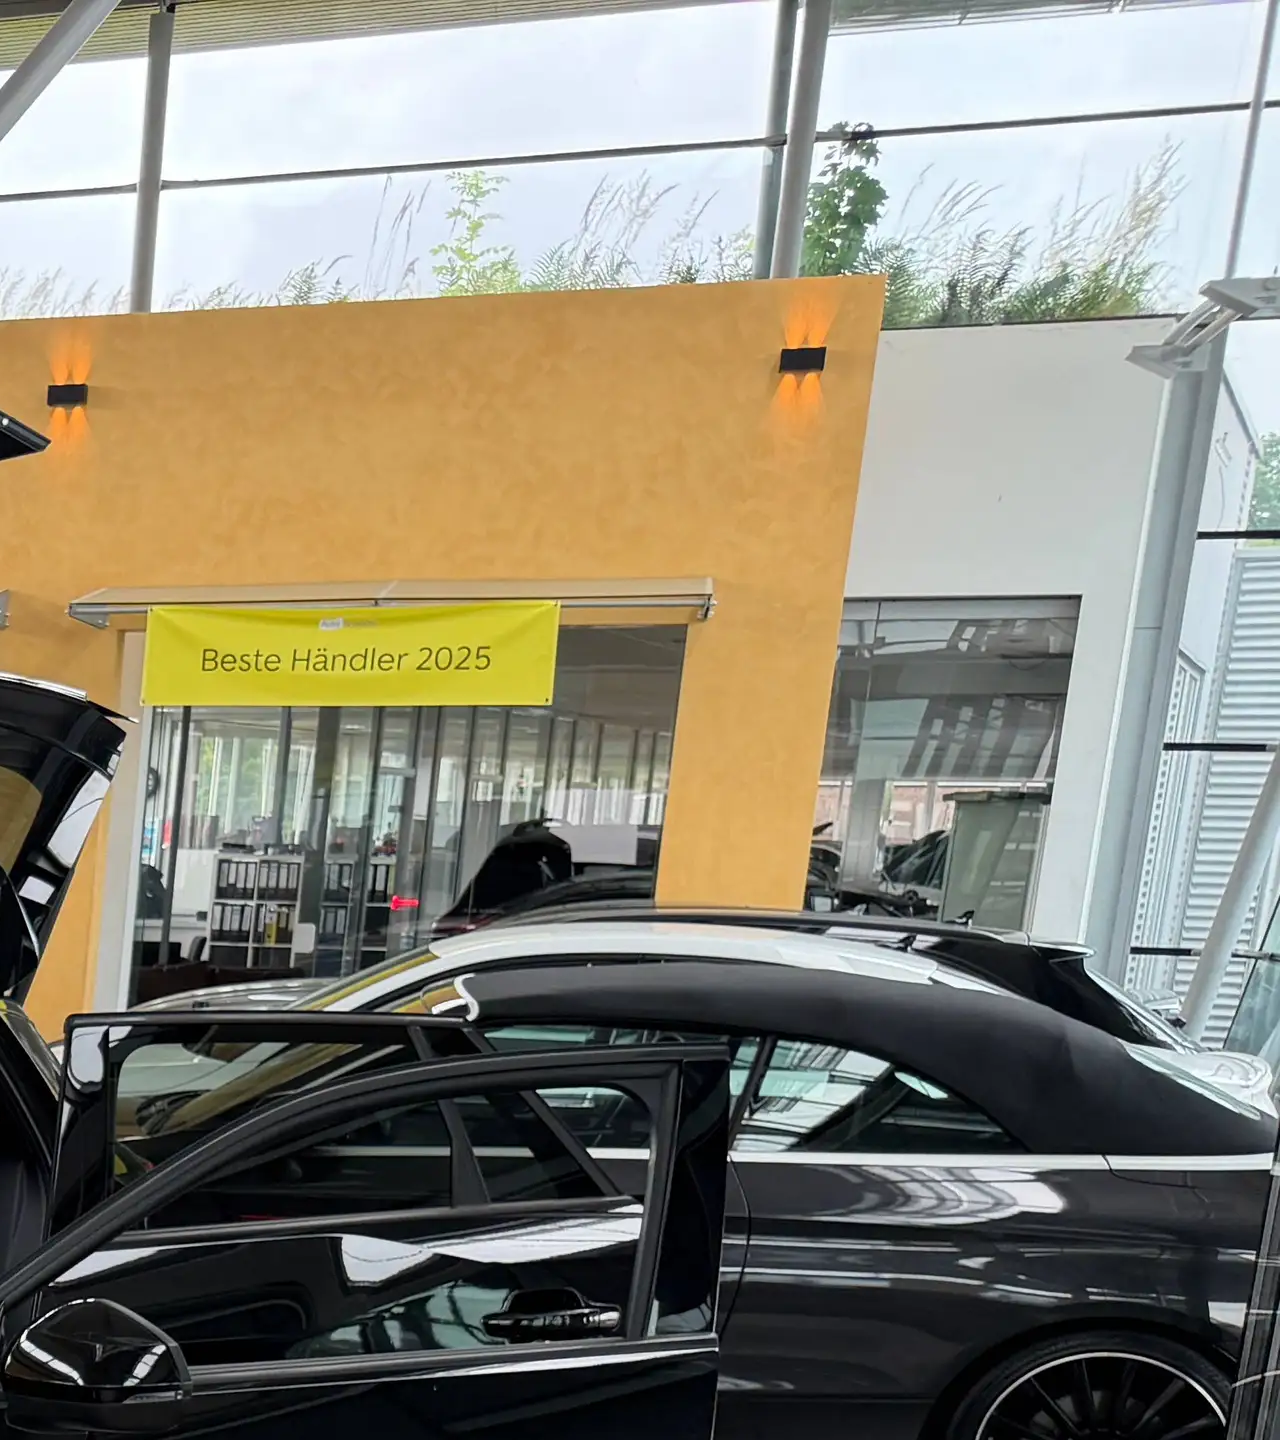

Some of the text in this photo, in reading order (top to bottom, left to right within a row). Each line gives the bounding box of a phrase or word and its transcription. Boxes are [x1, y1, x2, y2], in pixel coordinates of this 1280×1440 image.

[201, 645, 492, 673] Beste Händler 2025
